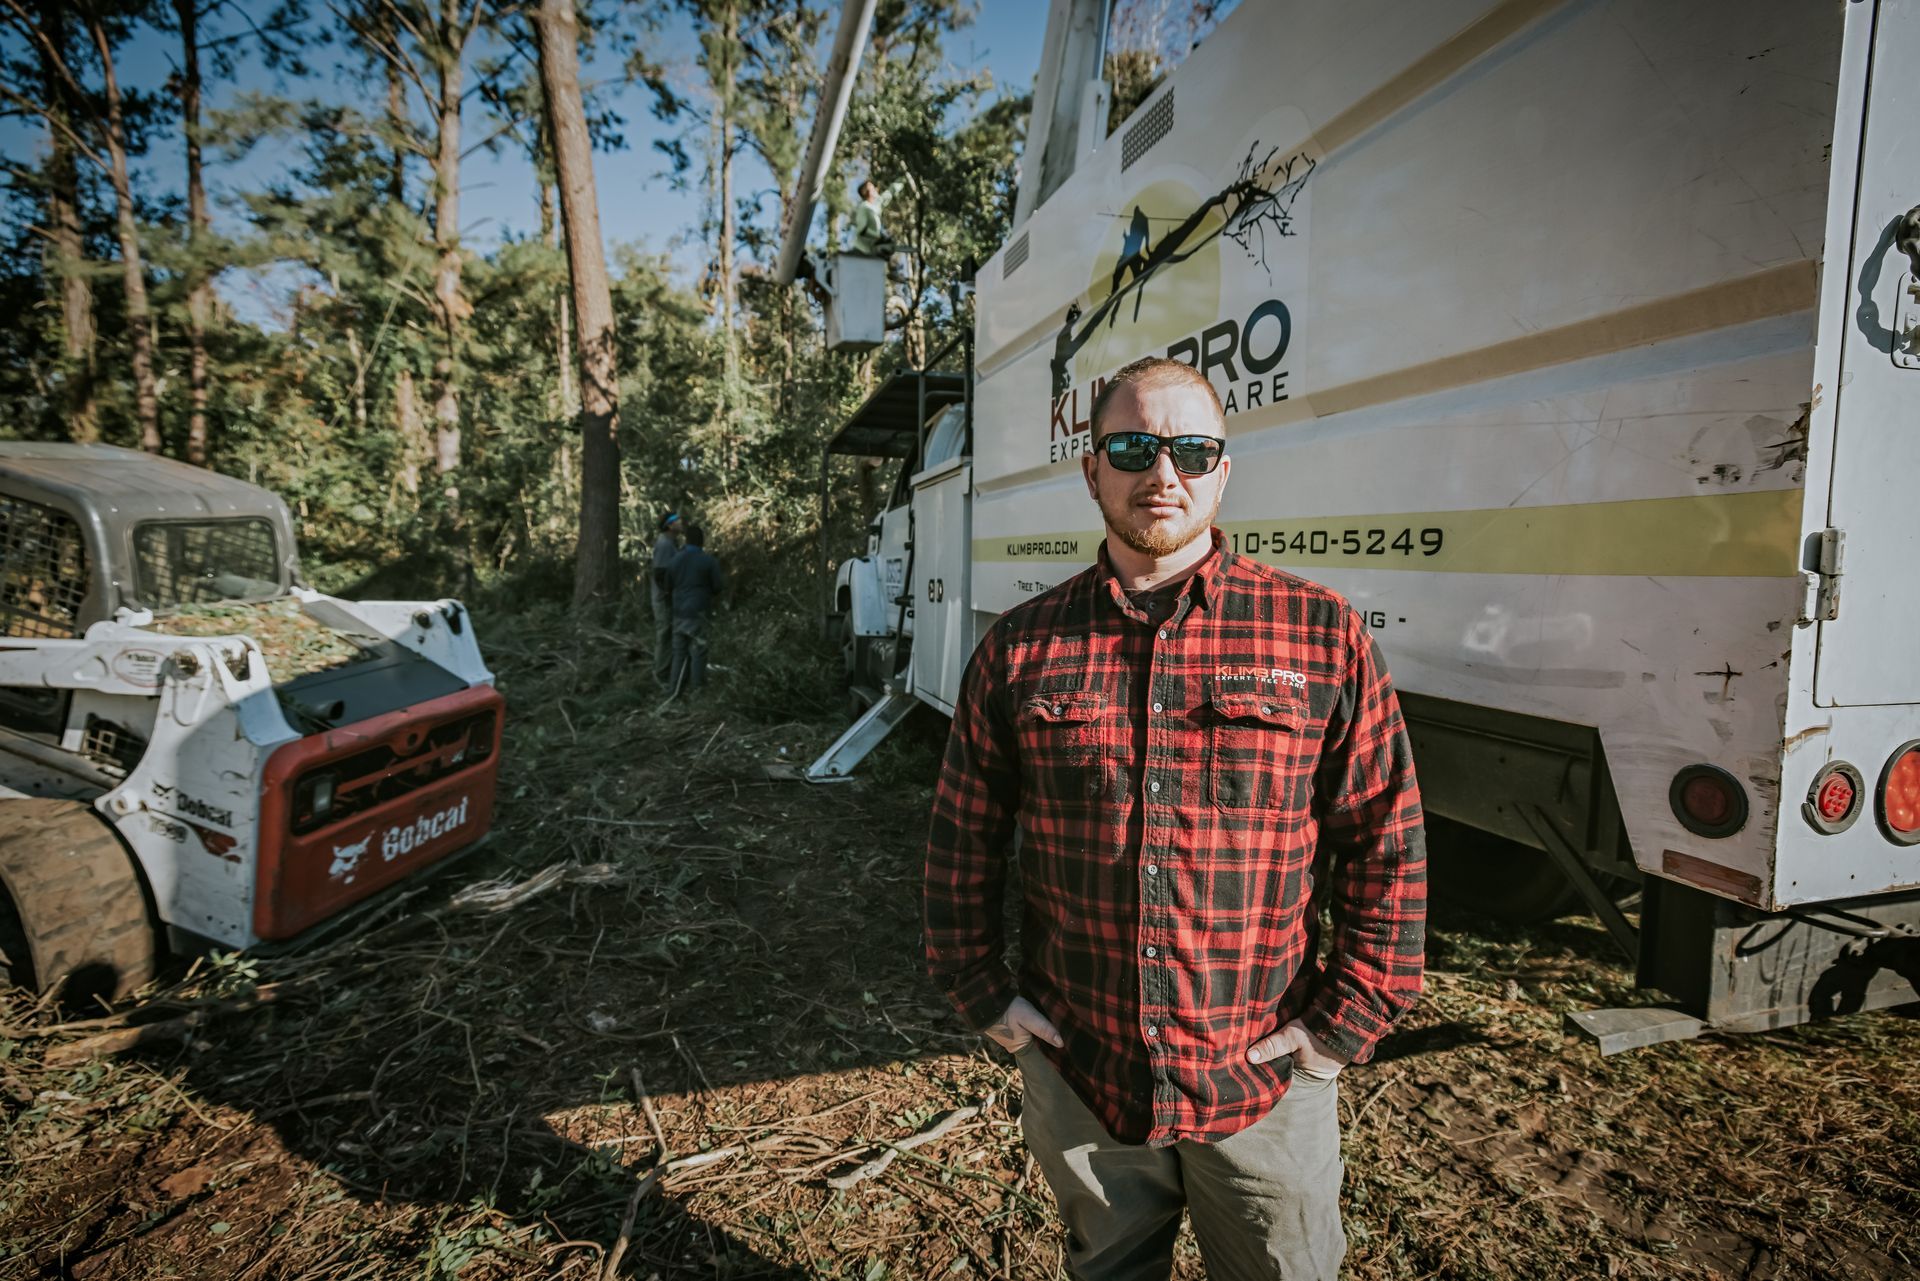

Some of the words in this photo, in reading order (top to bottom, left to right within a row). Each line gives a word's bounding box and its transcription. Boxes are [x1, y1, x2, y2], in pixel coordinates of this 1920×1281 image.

[1050, 434, 1091, 464] EXPE
[1223, 371, 1289, 416] ARE
[1007, 541, 1078, 556] KLIMBPRO.COM
[1232, 528, 1443, 556] 10-540-5249
[1215, 665, 1269, 679] KLIMB
[1271, 668, 1307, 684] PRO
[1254, 676, 1278, 684] TREE
[1281, 681, 1305, 689] CARE
[382, 796, 468, 862] Bobcat
